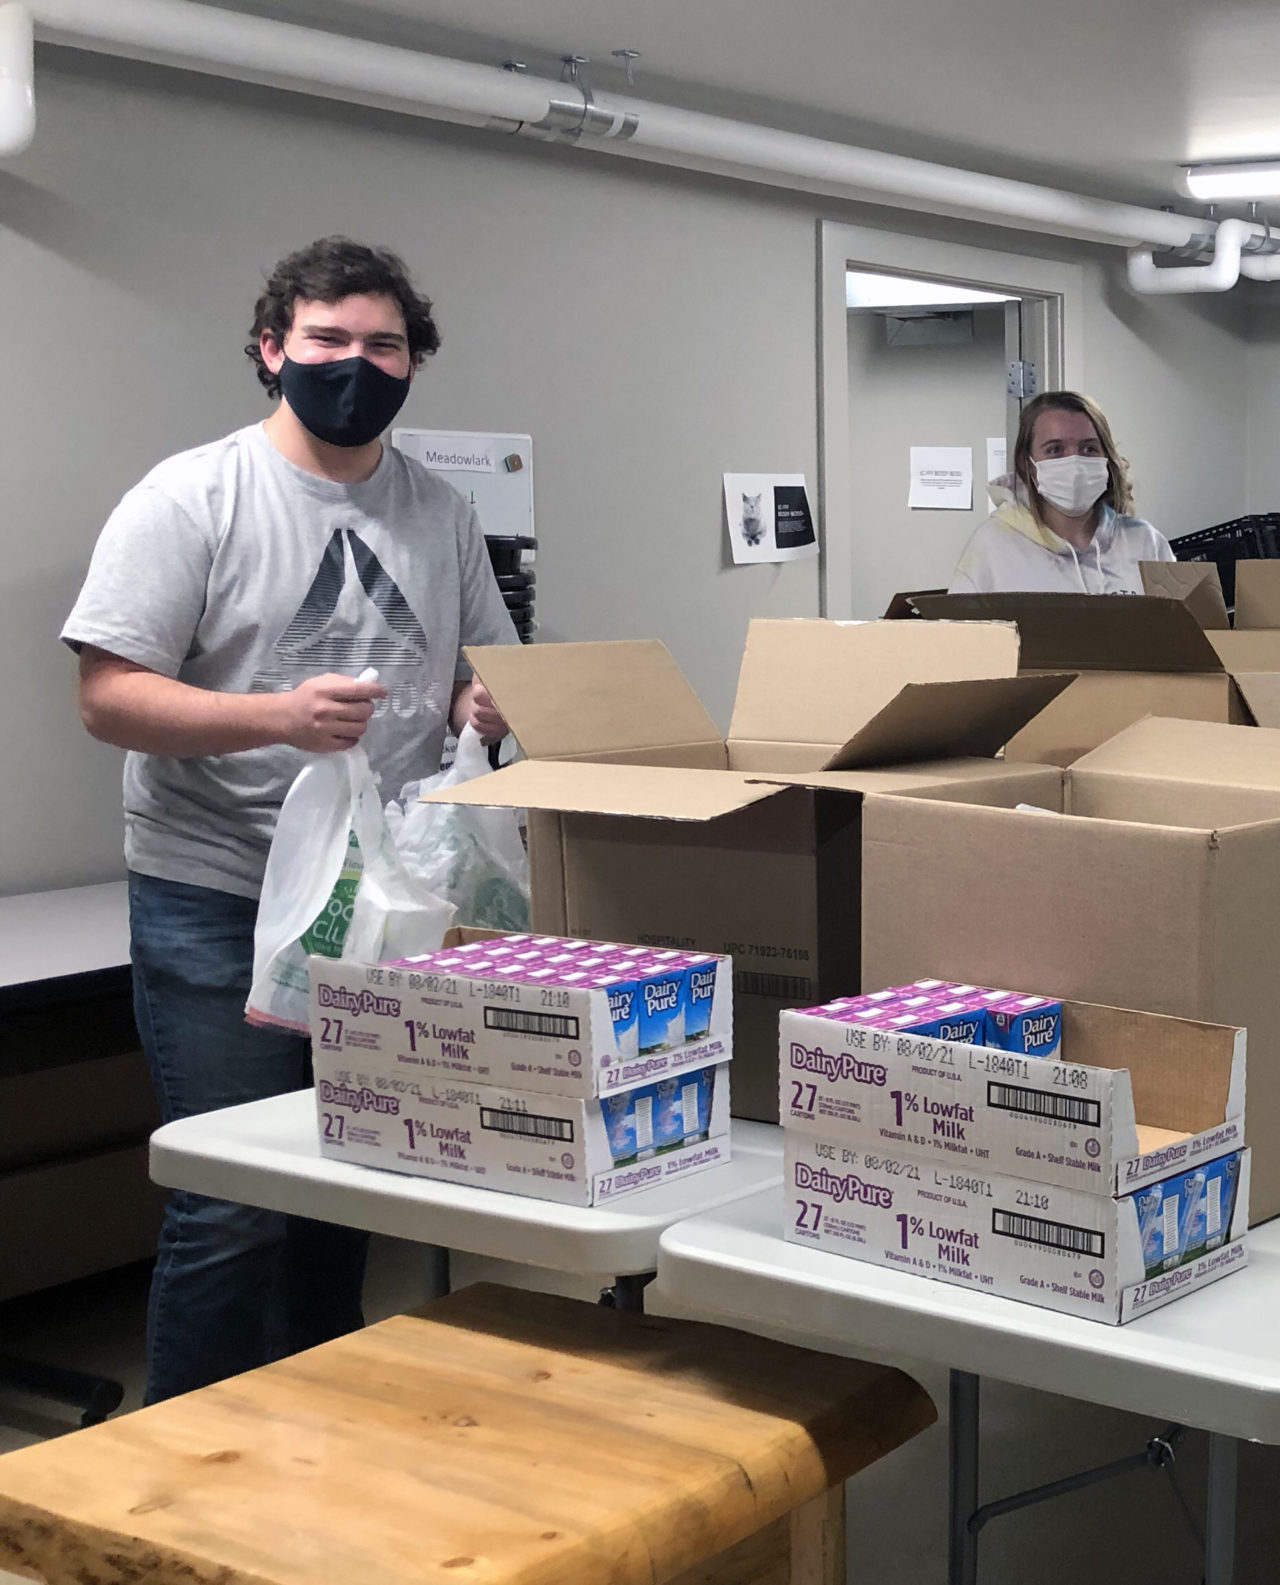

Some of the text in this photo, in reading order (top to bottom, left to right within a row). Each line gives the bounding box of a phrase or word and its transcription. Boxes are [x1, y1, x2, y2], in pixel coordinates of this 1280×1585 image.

[426, 451, 492, 467] Meadowlark
[637, 933, 697, 948] HOSPITALITY
[723, 942, 745, 955] UPC
[367, 968, 384, 985] USE
[318, 983, 401, 1018] DairyPure
[608, 991, 634, 1007] airy
[644, 980, 681, 1001] Dairy
[692, 984, 714, 1005] Pur
[320, 1017, 343, 1044] 27
[404, 1020, 430, 1052] 1%
[432, 1024, 476, 1044] Lowfat
[940, 1020, 979, 1041] Dairy
[1022, 1014, 1059, 1036] Dairy
[441, 1042, 470, 1060] Milk
[790, 1042, 886, 1086] DairyPure
[846, 1028, 1088, 1090] USE BY: 08/02/21 L-1840T1 21:08
[607, 1069, 620, 1083] 27
[912, 1065, 937, 1077] PRODUCT
[938, 1070, 946, 1078] OF
[319, 1080, 400, 1115] DairyPure
[791, 1080, 817, 1112] 27
[890, 1090, 919, 1127] 1%
[924, 1097, 975, 1123] Lowfat
[323, 1113, 345, 1139] 27
[403, 1118, 427, 1149] 1%
[430, 1123, 472, 1144] Lowfat
[933, 1118, 966, 1140] Milk
[439, 1141, 467, 1160] Milk
[879, 1128, 990, 1159] Vitamin A & D 1% Milkfat UHT
[1126, 1158, 1140, 1176] 27
[1143, 1145, 1187, 1170] DairyPure
[1203, 1130, 1224, 1145] Lowfat
[1226, 1125, 1237, 1135] Milk
[1016, 1147, 1101, 1173] Grade A Shelf Stable Milk
[599, 1178, 612, 1193] 27
[795, 1162, 893, 1209] DairyPure
[815, 1143, 1049, 1210] USE BY: 08/02/21 L-1840T1 21:10
[917, 1189, 943, 1202] PRODUCT
[943, 1195, 951, 1203] OF
[795, 1199, 823, 1231] 27
[795, 1229, 820, 1240] CARTONS
[896, 1213, 924, 1249] 1%
[929, 1221, 980, 1249] Lowfat
[885, 1250, 994, 1285] Vitamin A & D 1% Milkfat UHT
[938, 1243, 970, 1266] Milk
[1133, 1284, 1146, 1302] 27
[1208, 1253, 1229, 1267] Lowfat
[1231, 1244, 1243, 1255] Milk
[1020, 1275, 1105, 1304] Grade A Shelf Stable Milk
